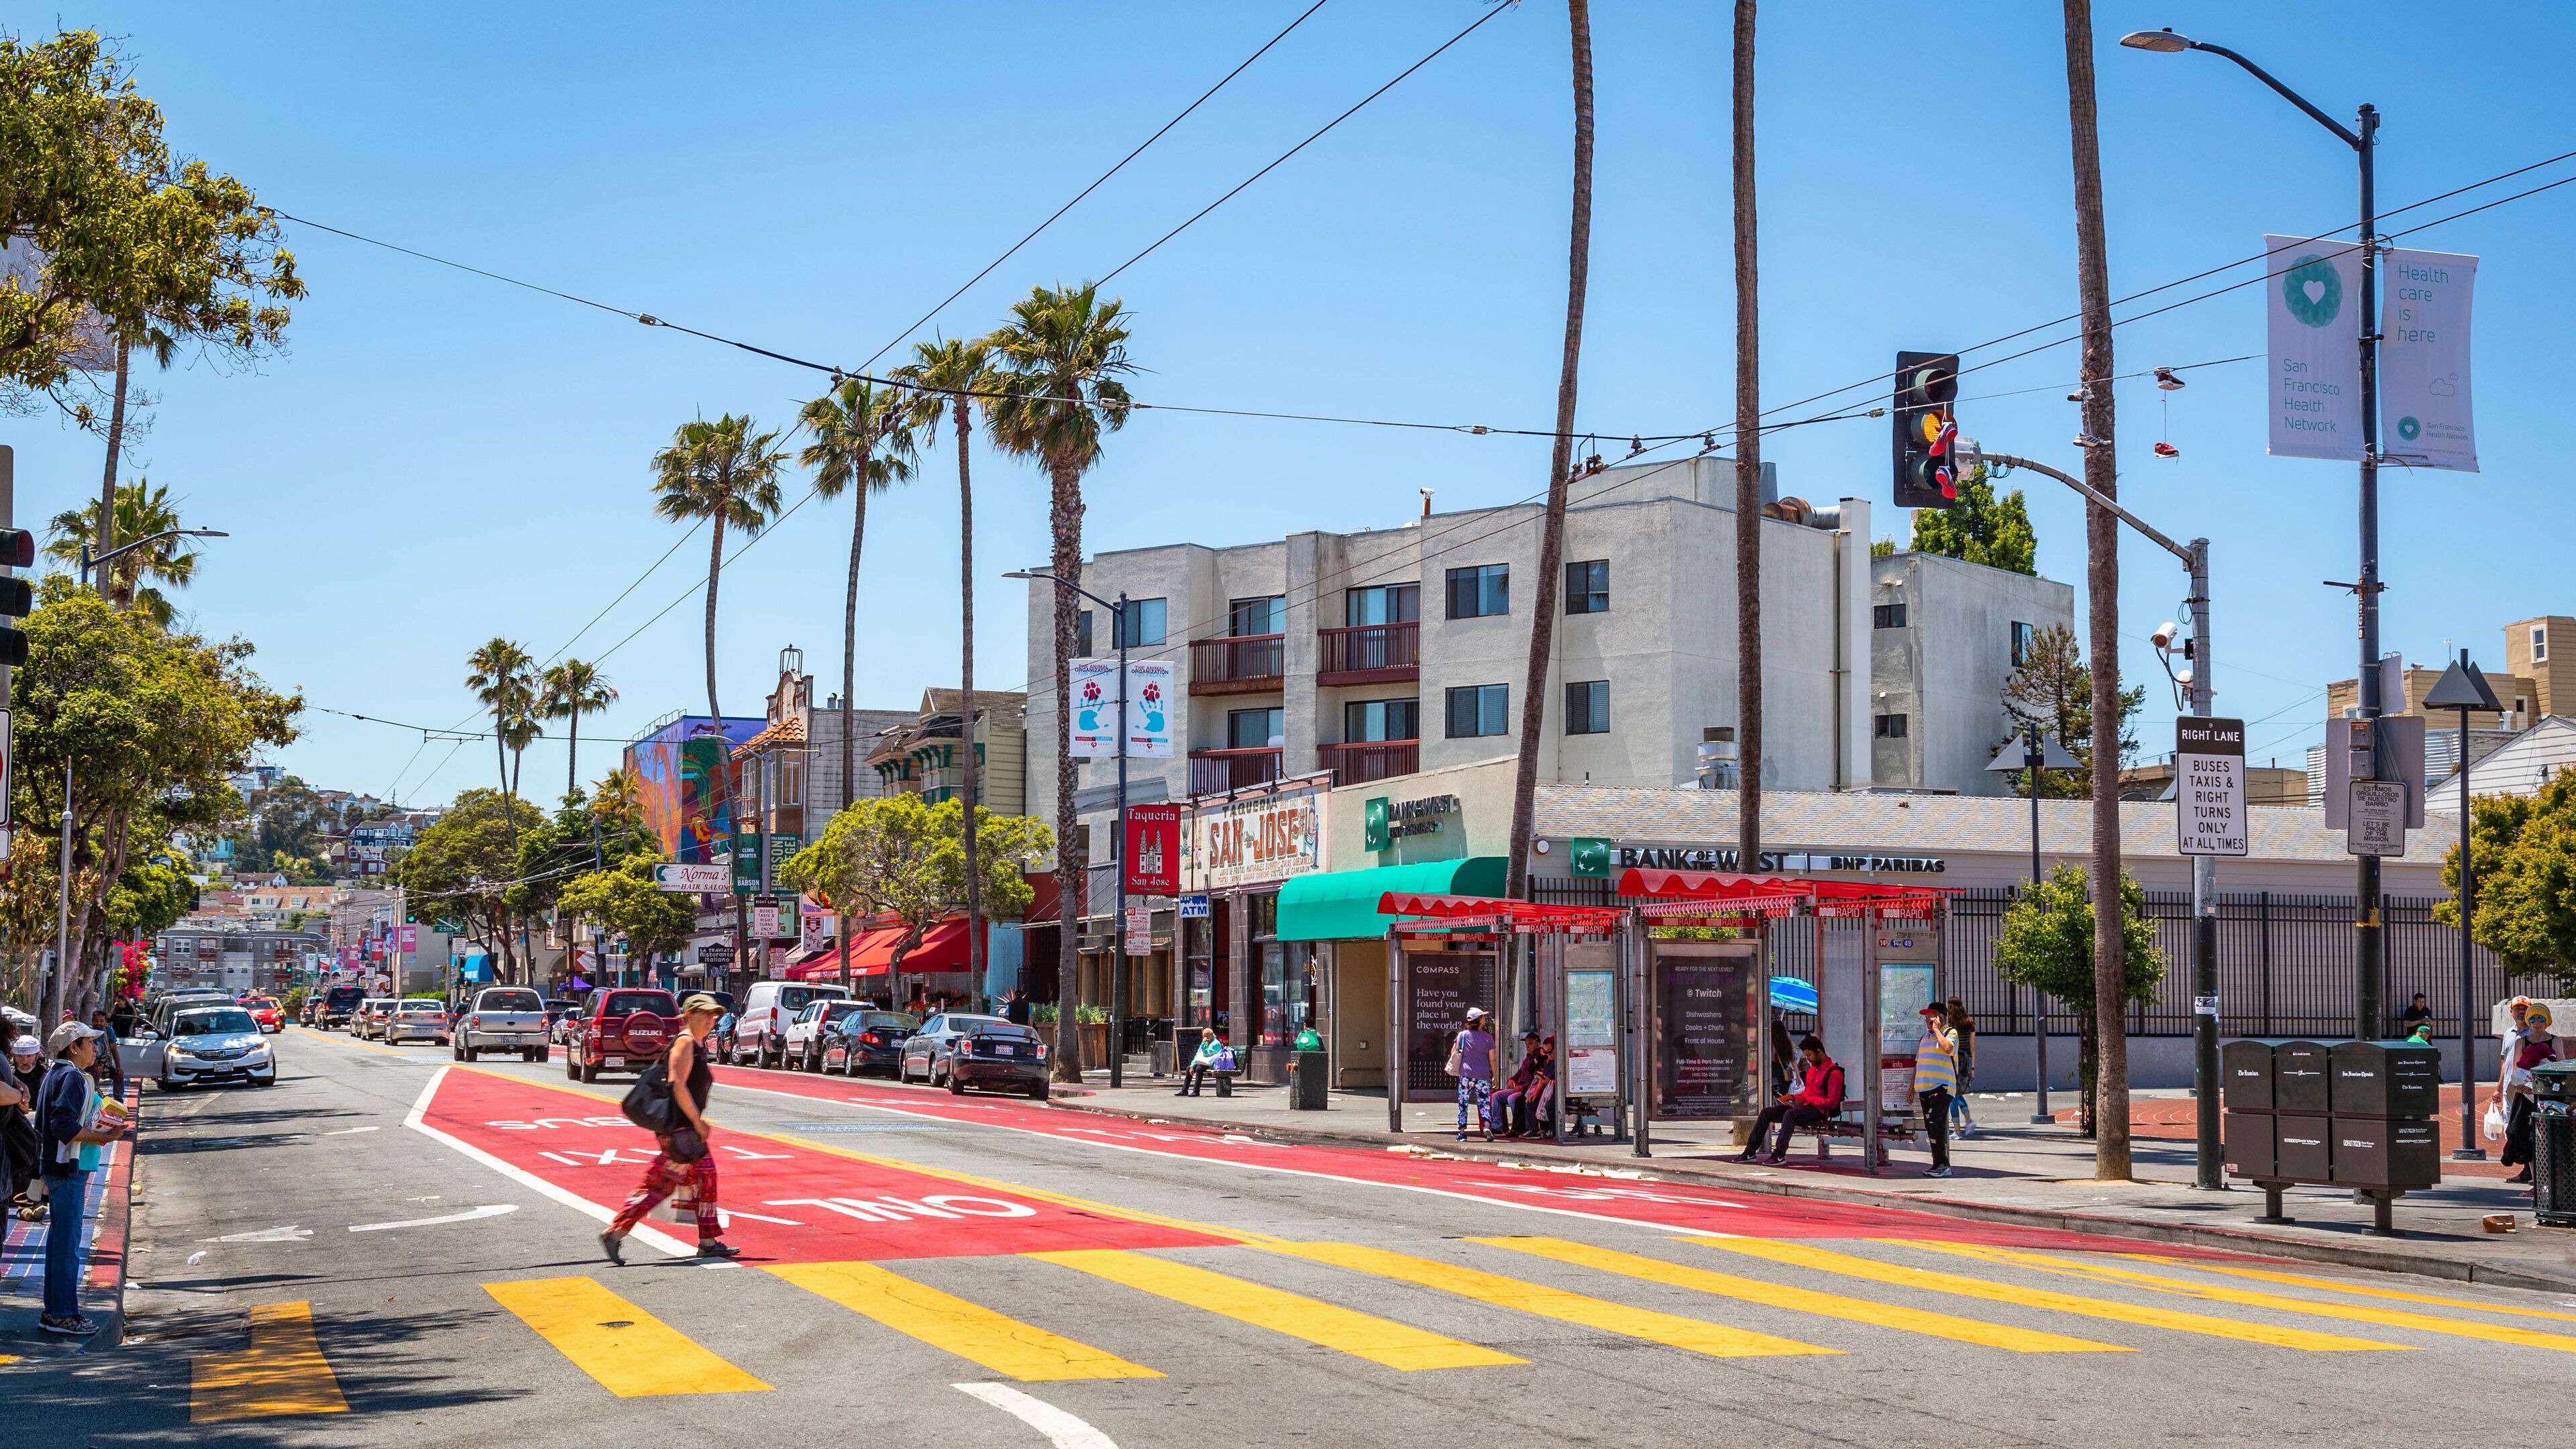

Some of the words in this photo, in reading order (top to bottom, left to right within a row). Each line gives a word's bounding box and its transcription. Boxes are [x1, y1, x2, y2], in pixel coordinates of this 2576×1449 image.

[2399, 264, 2449, 284] Health
[2399, 288, 2432, 302] care
[2399, 306, 2411, 321] is
[2398, 326, 2435, 342] here
[2284, 358, 2308, 373] San
[2284, 378, 2340, 396] Francisco
[2284, 397, 2324, 413] Health
[2285, 416, 2337, 433] Network
[2439, 423, 2465, 431] Francisco
[2182, 729, 2210, 741] RIGHT
[2214, 731, 2240, 741] LANE
[2193, 760, 2229, 772] BUSES
[2189, 775, 2221, 788] TAXIS
[2226, 777, 2234, 788] &
[2196, 792, 2229, 803] RIGHT
[1222, 796, 1278, 818] TAQUERIA
[1389, 800, 1416, 822] BANK
[1423, 794, 1453, 814] WEST
[2194, 806, 2231, 818] TURNS
[1127, 808, 1175, 822] Taqueria
[1389, 826, 1403, 839] BNP
[1405, 820, 1436, 837] PARIBAS
[2198, 822, 2227, 834] ONLY
[1210, 818, 1244, 869] SAN
[1253, 808, 1299, 863] JOSE
[2183, 837, 2193, 848] AT
[2197, 837, 2212, 849] ALL
[2217, 838, 2243, 849] TIMES
[1620, 847, 1692, 870] BANK
[1696, 851, 1712, 861] OF
[1716, 850, 1790, 872] WST
[771, 840, 784, 886] BABSON
[1246, 863, 1265, 872] NATURALES
[1282, 859, 1291, 867] TACOS
[1692, 861, 1717, 871] THE
[1830, 857, 1867, 870] BNP
[1871, 858, 1945, 872] PARIBAS
[680, 866, 728, 882] Norma's
[1230, 874, 1241, 882] CARNES
[1132, 875, 1147, 887] San
[1150, 876, 1170, 885] Jose
[1181, 906, 1207, 915] ATM
[1837, 908, 1860, 917] RAPID
[1900, 909, 1923, 919] RAPID
[1679, 918, 1701, 926] RAPID
[1722, 918, 1743, 927] RAPID
[1530, 925, 1551, 933] RAPID
[1585, 926, 1605, 934] RAPID
[1466, 933, 1485, 941] RAPID
[1416, 966, 1460, 974] COMPASS
[1417, 988, 1440, 997] Have
[1441, 991, 1458, 999] you
[1686, 988, 1693, 998] @
[1695, 988, 1722, 998] Twitch
[1417, 999, 1443, 1008] found
[1445, 1002, 1466, 1010] your
[1417, 1010, 1440, 1020] place
[1441, 1010, 1450, 1019] in
[1417, 1021, 1432, 1029] the
[1433, 1021, 1462, 1030] world?
[484, 1116, 638, 1131] BUS
[537, 1145, 794, 1166] TXI
